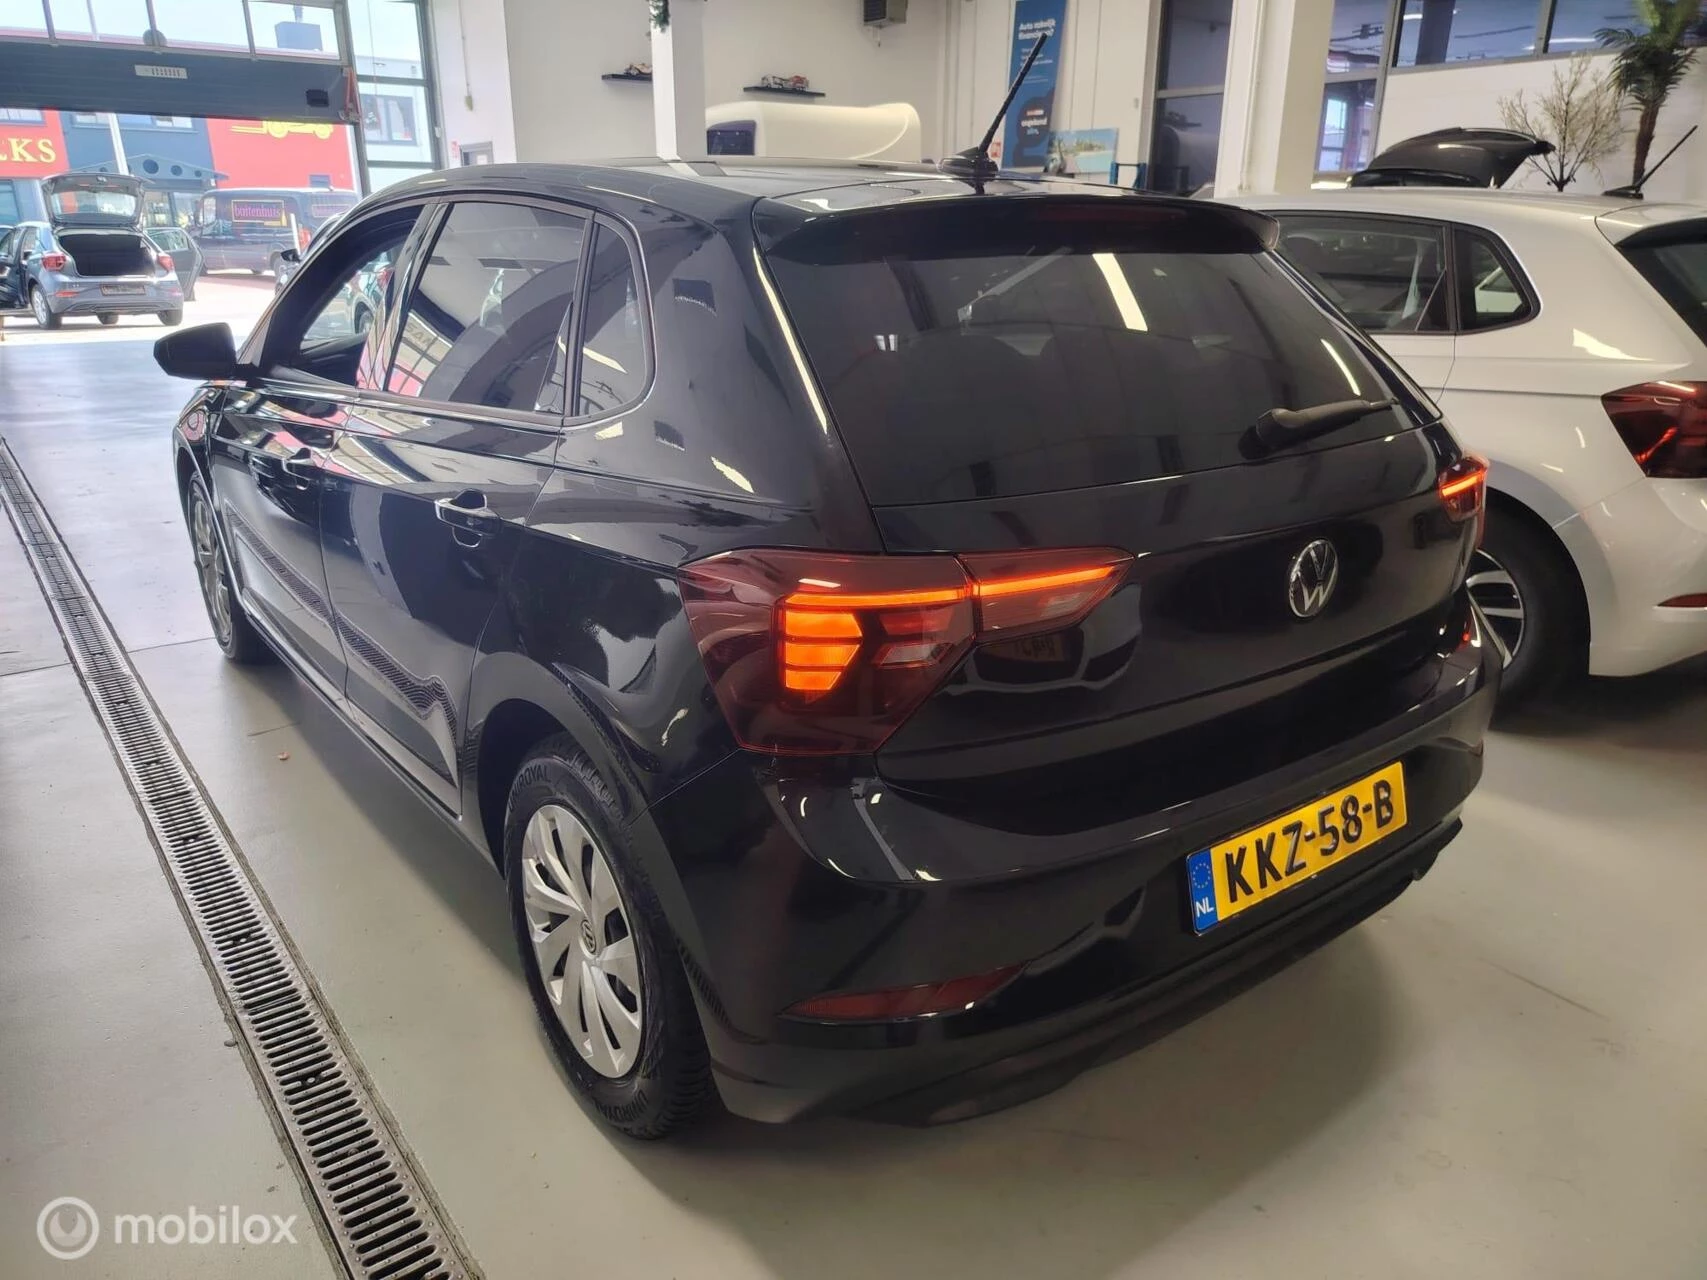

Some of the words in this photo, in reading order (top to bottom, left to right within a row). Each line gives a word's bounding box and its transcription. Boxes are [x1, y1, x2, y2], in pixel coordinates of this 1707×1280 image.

[0, 137, 56, 163] KS
[508, 764, 551, 813] UNIROYAL
[1225, 779, 1394, 904] KKZ-58-B
[1195, 896, 1215, 918] NL
